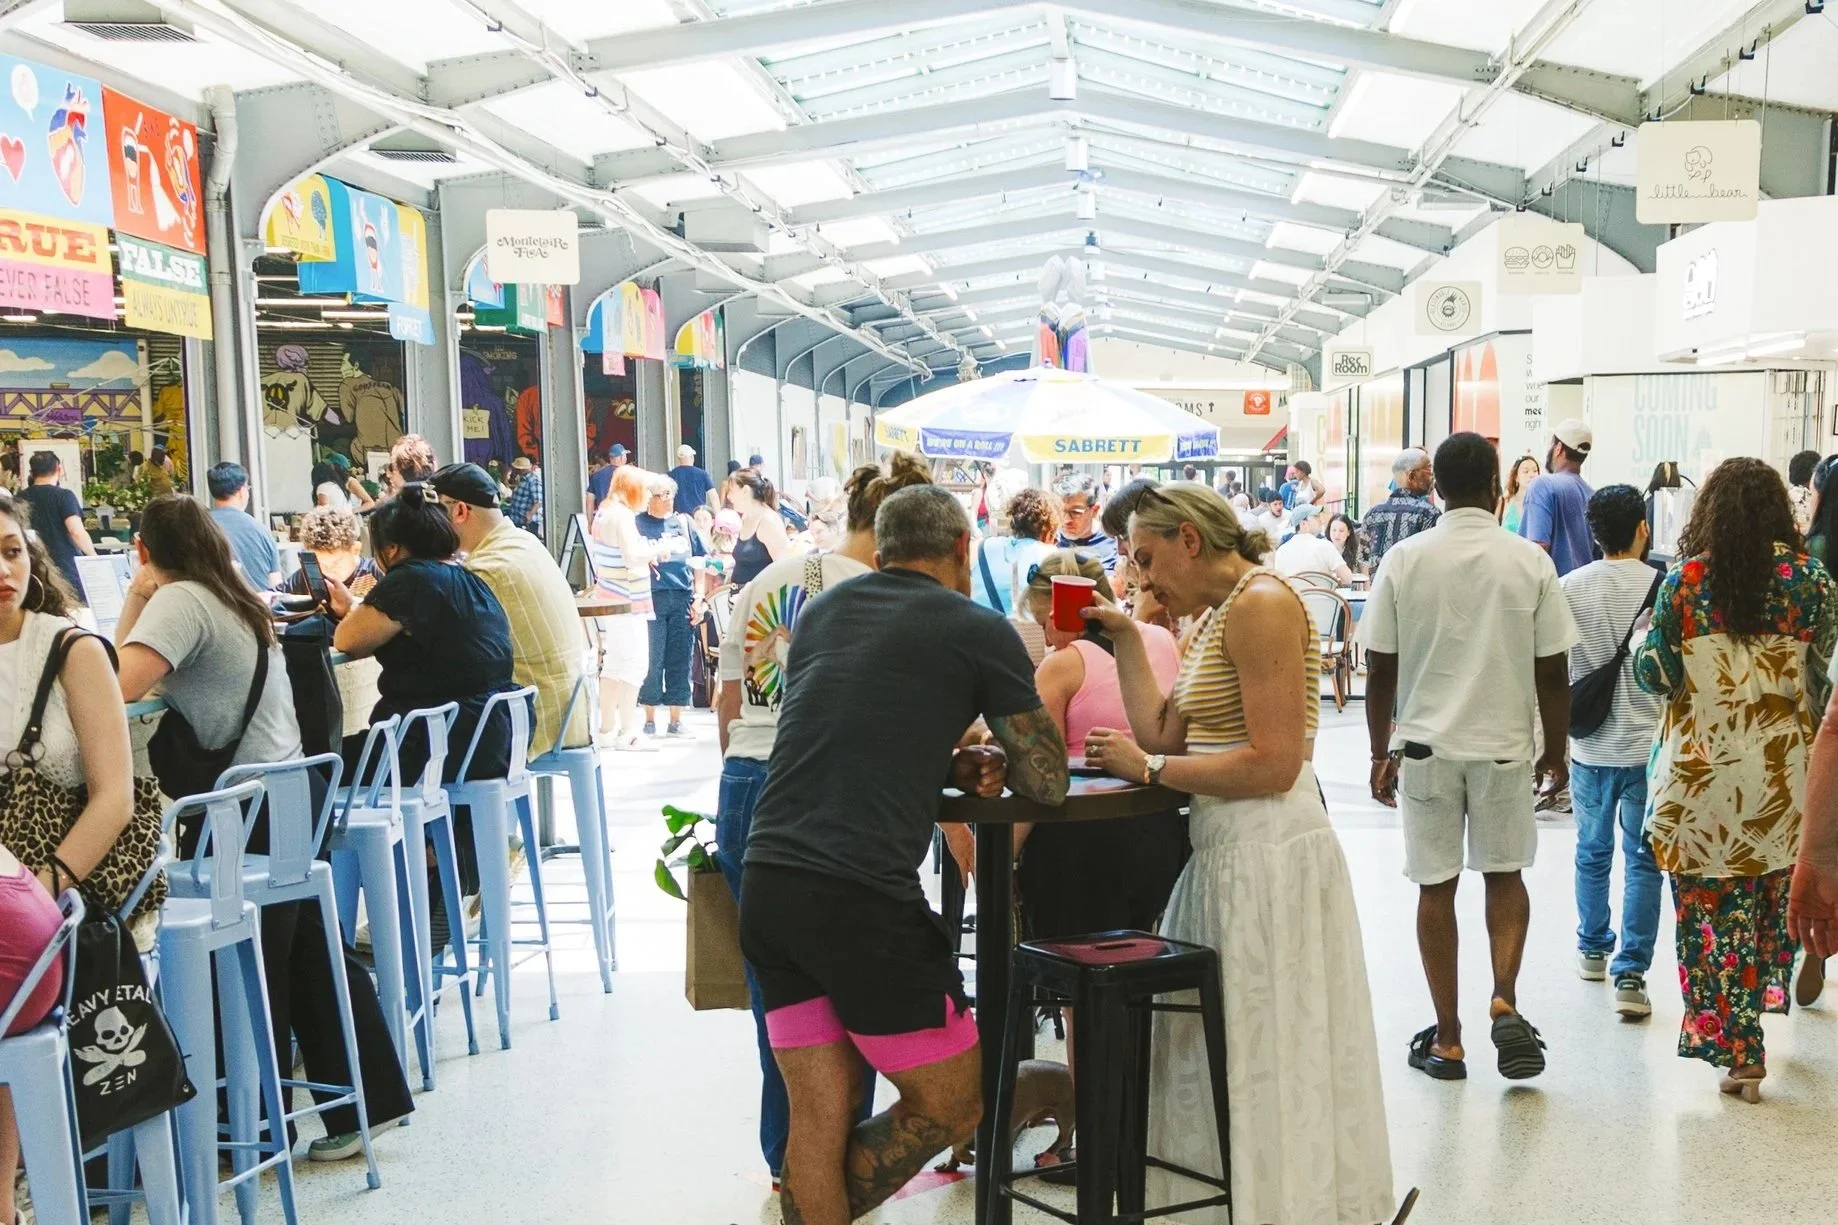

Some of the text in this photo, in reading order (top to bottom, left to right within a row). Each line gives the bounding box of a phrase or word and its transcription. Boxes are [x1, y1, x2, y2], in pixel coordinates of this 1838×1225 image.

[1650, 183, 1747, 199] little bear
[118, 240, 202, 288] FALSE
[44, 274, 91, 307] FALSE
[132, 288, 199, 329] ALWAYS UNTRUE
[1335, 363, 1368, 374] Room
[1341, 354, 1362, 365] Rec
[1634, 375, 1718, 412] COMING
[463, 415, 484, 423] KICK
[953, 439, 966, 449] ON
[967, 441, 974, 449] A
[974, 441, 994, 451] ROLL
[1055, 439, 1142, 453] SABRETT
[1632, 414, 1688, 462] SOON
[66, 989, 109, 1029] EAVY
[100, 1068, 137, 1095] ZEN
